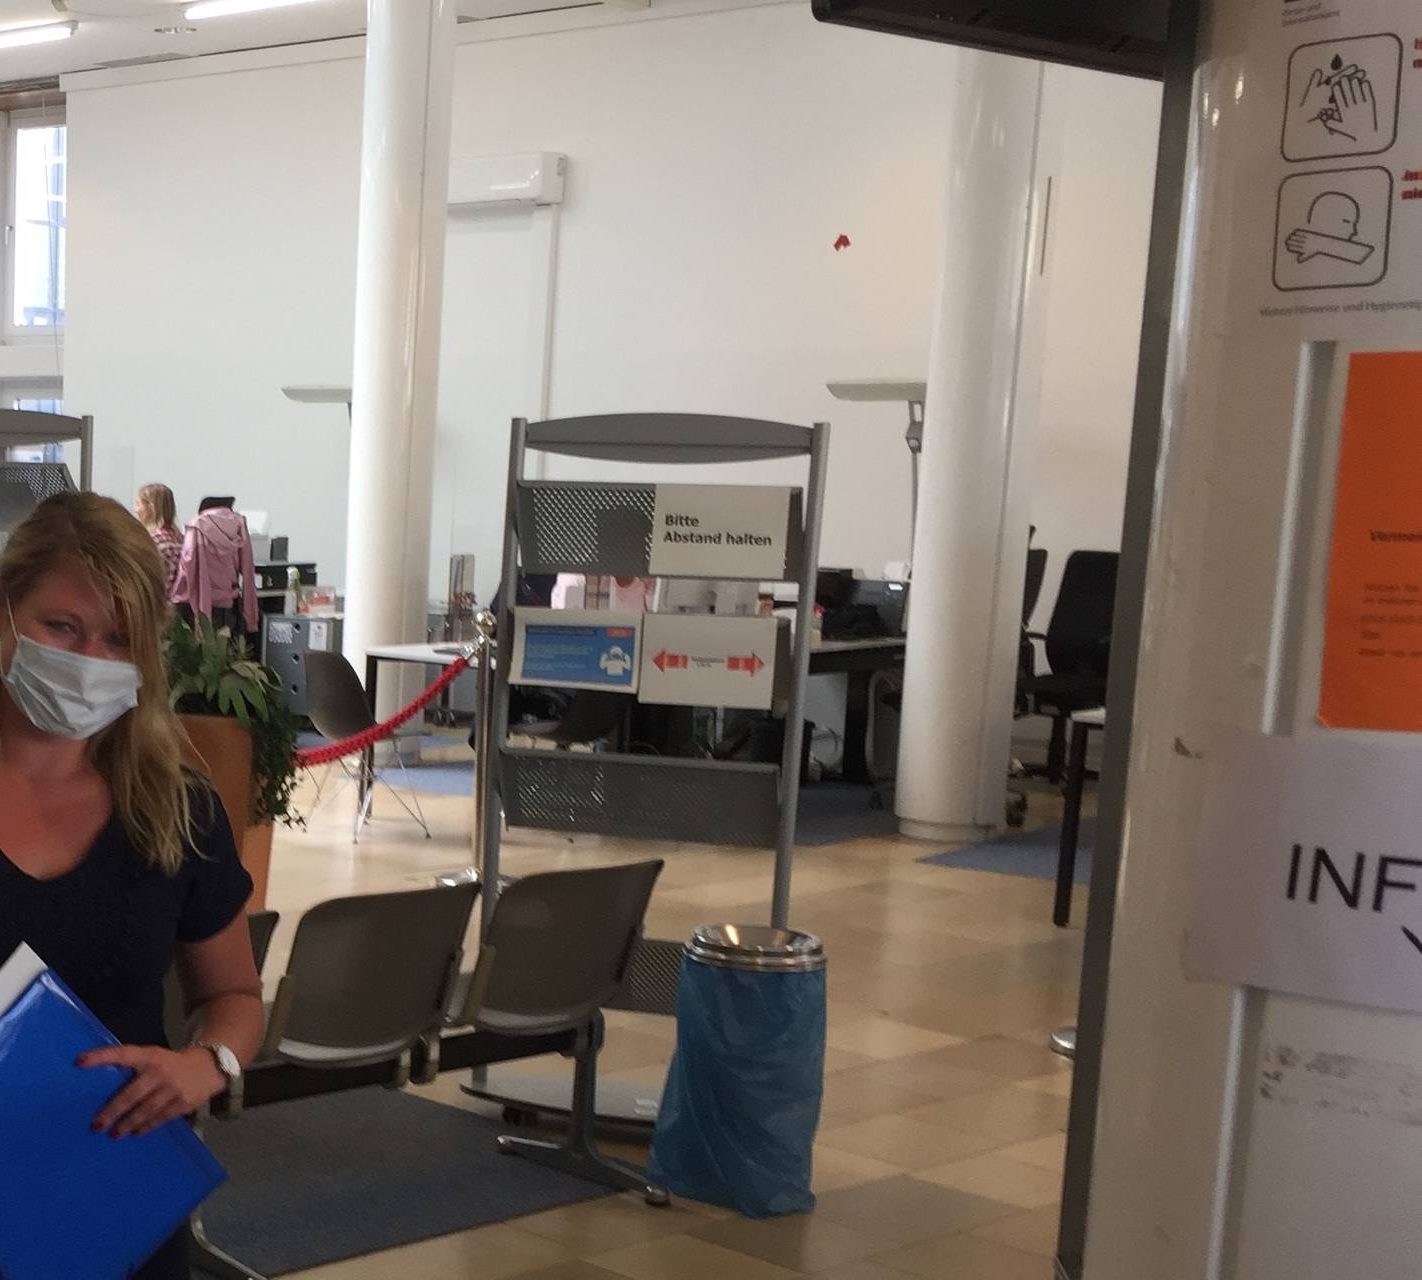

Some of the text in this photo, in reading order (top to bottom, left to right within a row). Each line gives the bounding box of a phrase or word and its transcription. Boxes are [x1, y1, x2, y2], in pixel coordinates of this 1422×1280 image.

[665, 514, 700, 527] Bitte
[664, 531, 772, 546] Abstand halten
[1286, 843, 1422, 914] INF
